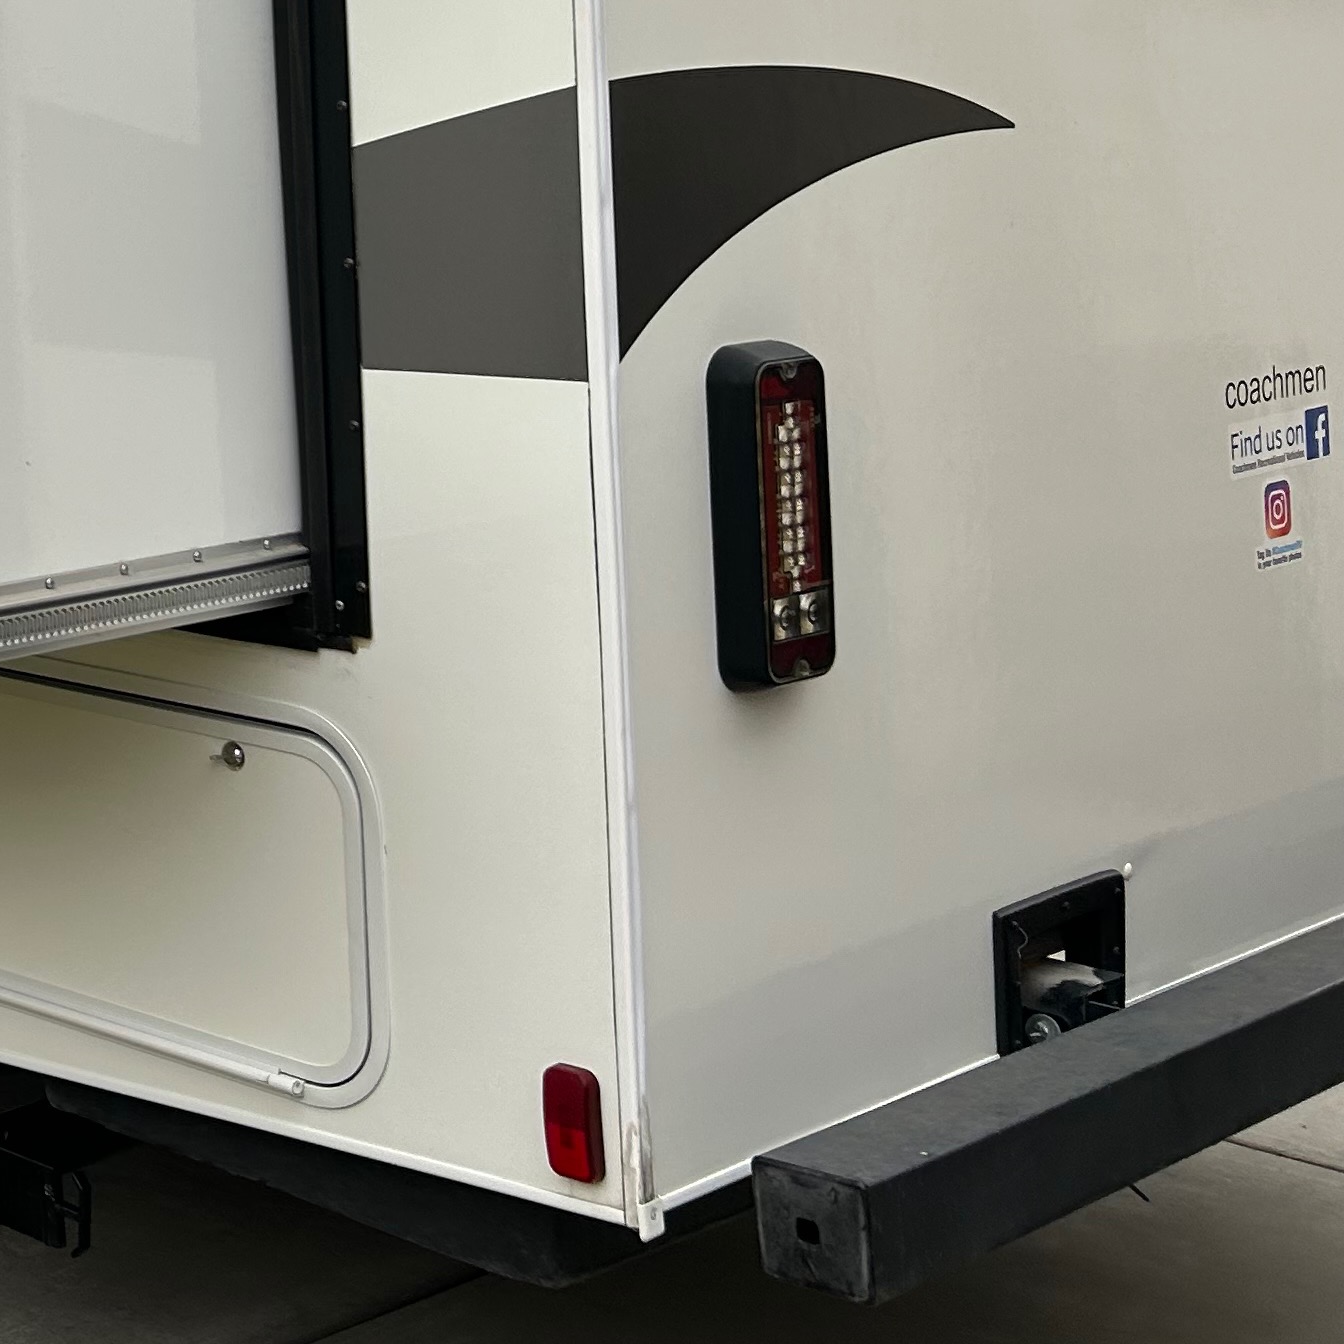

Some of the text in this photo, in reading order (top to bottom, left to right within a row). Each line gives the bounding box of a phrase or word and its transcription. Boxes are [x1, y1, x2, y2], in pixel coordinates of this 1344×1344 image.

[1225, 364, 1326, 409] coachmen
[1231, 425, 1262, 460] Find
[1266, 429, 1282, 451] us
[1286, 424, 1304, 447] on
